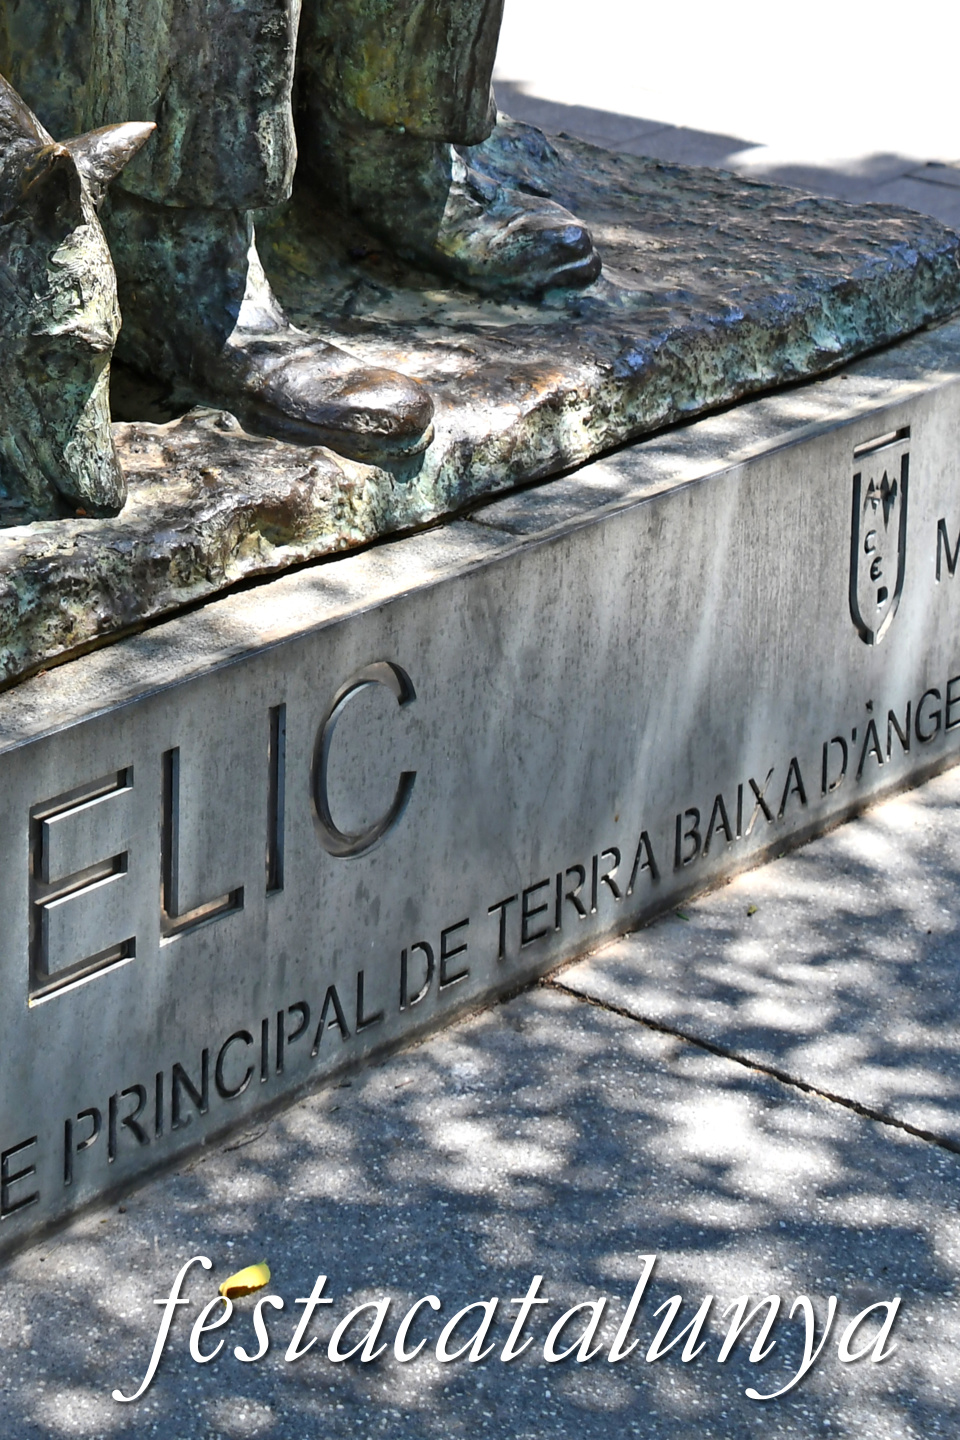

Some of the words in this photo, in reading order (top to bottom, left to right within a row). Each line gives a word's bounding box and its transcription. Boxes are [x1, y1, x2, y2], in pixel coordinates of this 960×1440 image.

[62, 968, 385, 1188] PRINCIPAL
[399, 918, 470, 1012] DE
[486, 830, 662, 962] TERRA
[672, 755, 809, 874] BAIXA
